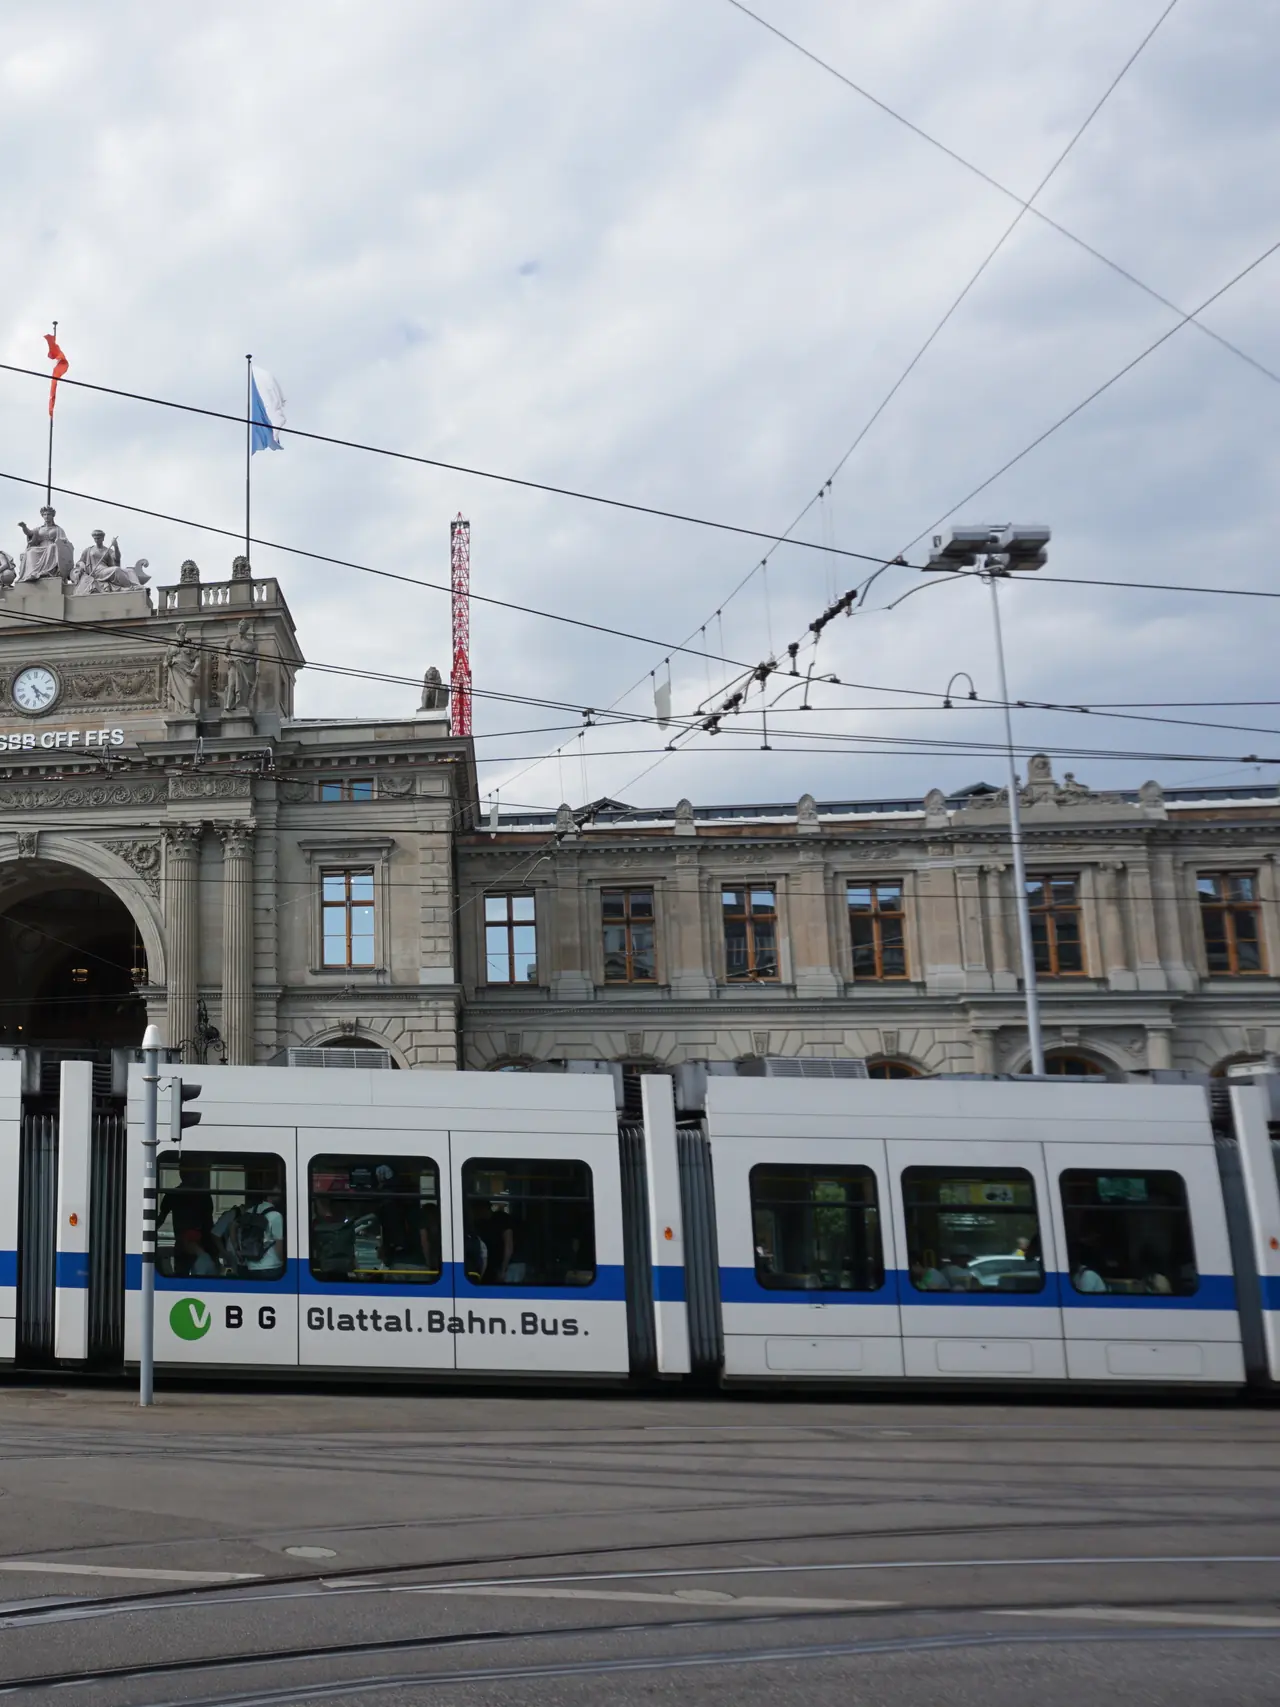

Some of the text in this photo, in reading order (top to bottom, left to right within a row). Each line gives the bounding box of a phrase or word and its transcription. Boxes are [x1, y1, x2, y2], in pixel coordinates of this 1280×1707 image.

[40, 731, 80, 749] CFF
[85, 729, 124, 747] FFS
[306, 1307, 590, 1337] Glattal.Bahn.Bus.
